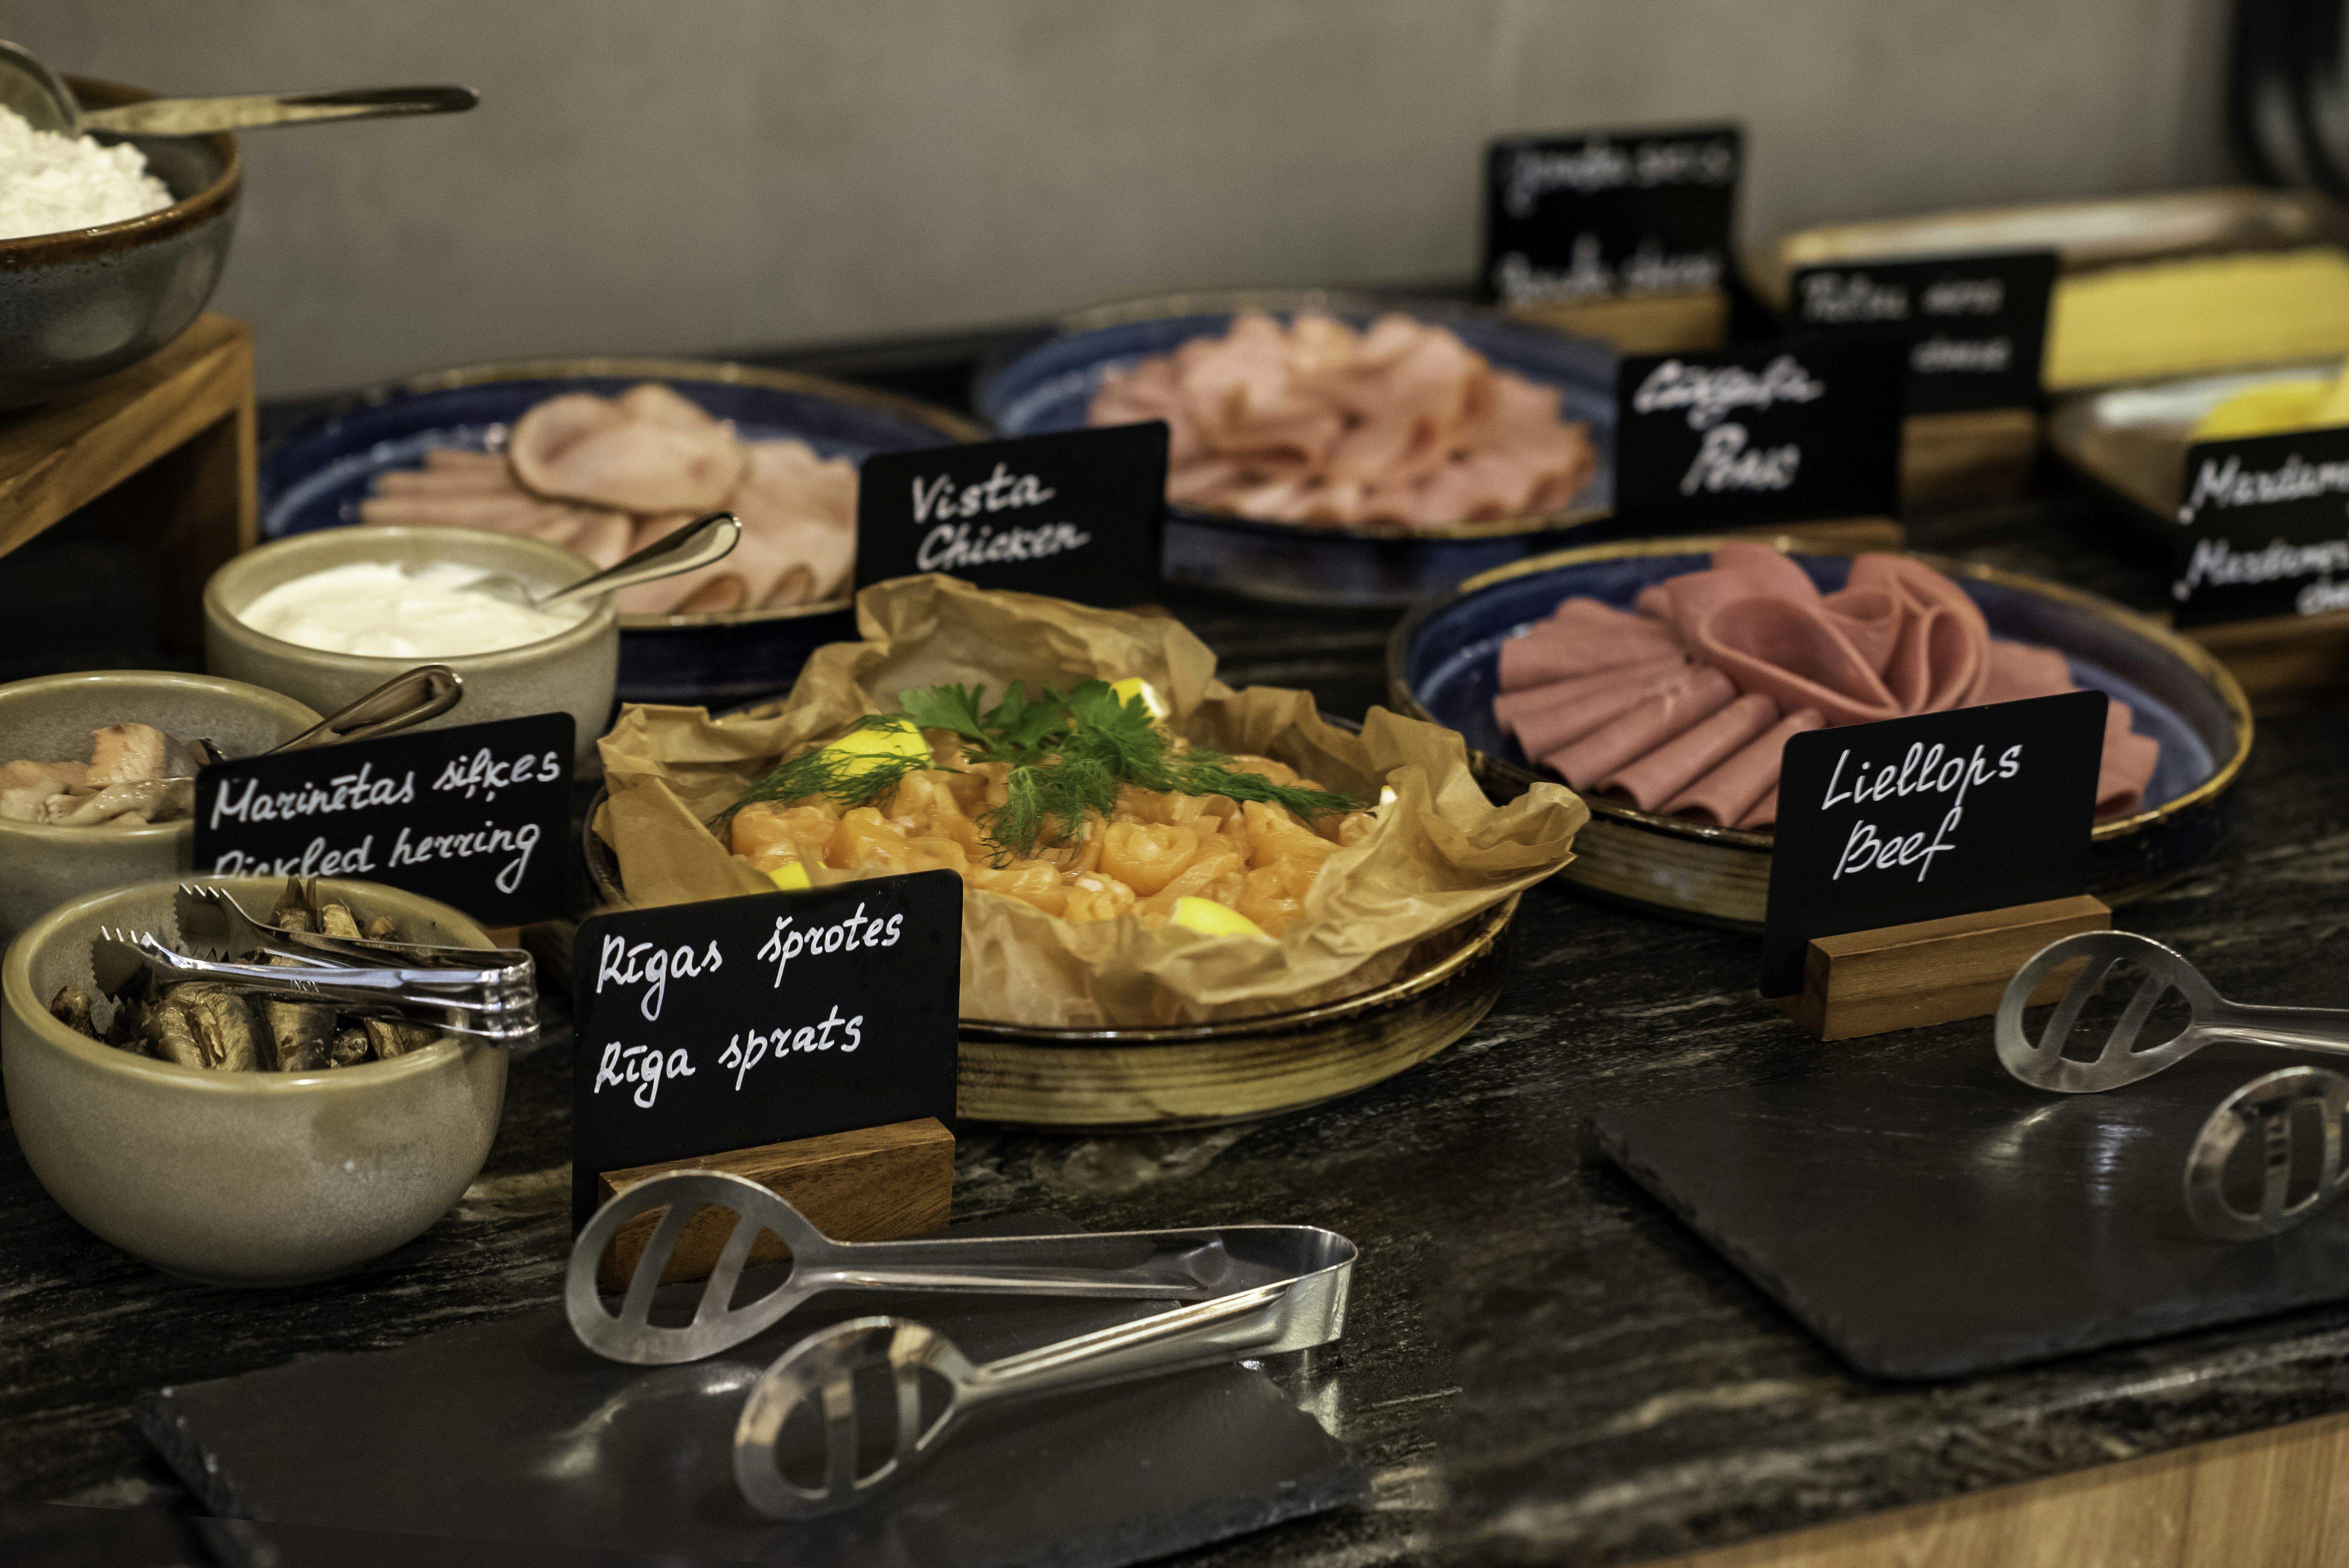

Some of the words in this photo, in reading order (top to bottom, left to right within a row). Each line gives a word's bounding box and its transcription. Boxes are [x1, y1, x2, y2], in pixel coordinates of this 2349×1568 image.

[912, 462, 1056, 524] Vista
[916, 522, 1091, 571] Chicken
[1821, 742, 2023, 810] Liellops
[388, 820, 540, 894] herring
[1832, 805, 1964, 882] Beef
[596, 934, 722, 1021] Rīgas
[757, 902, 904, 989] šprotes
[593, 1041, 696, 1109] Rīga
[718, 1005, 864, 1091] sprats
